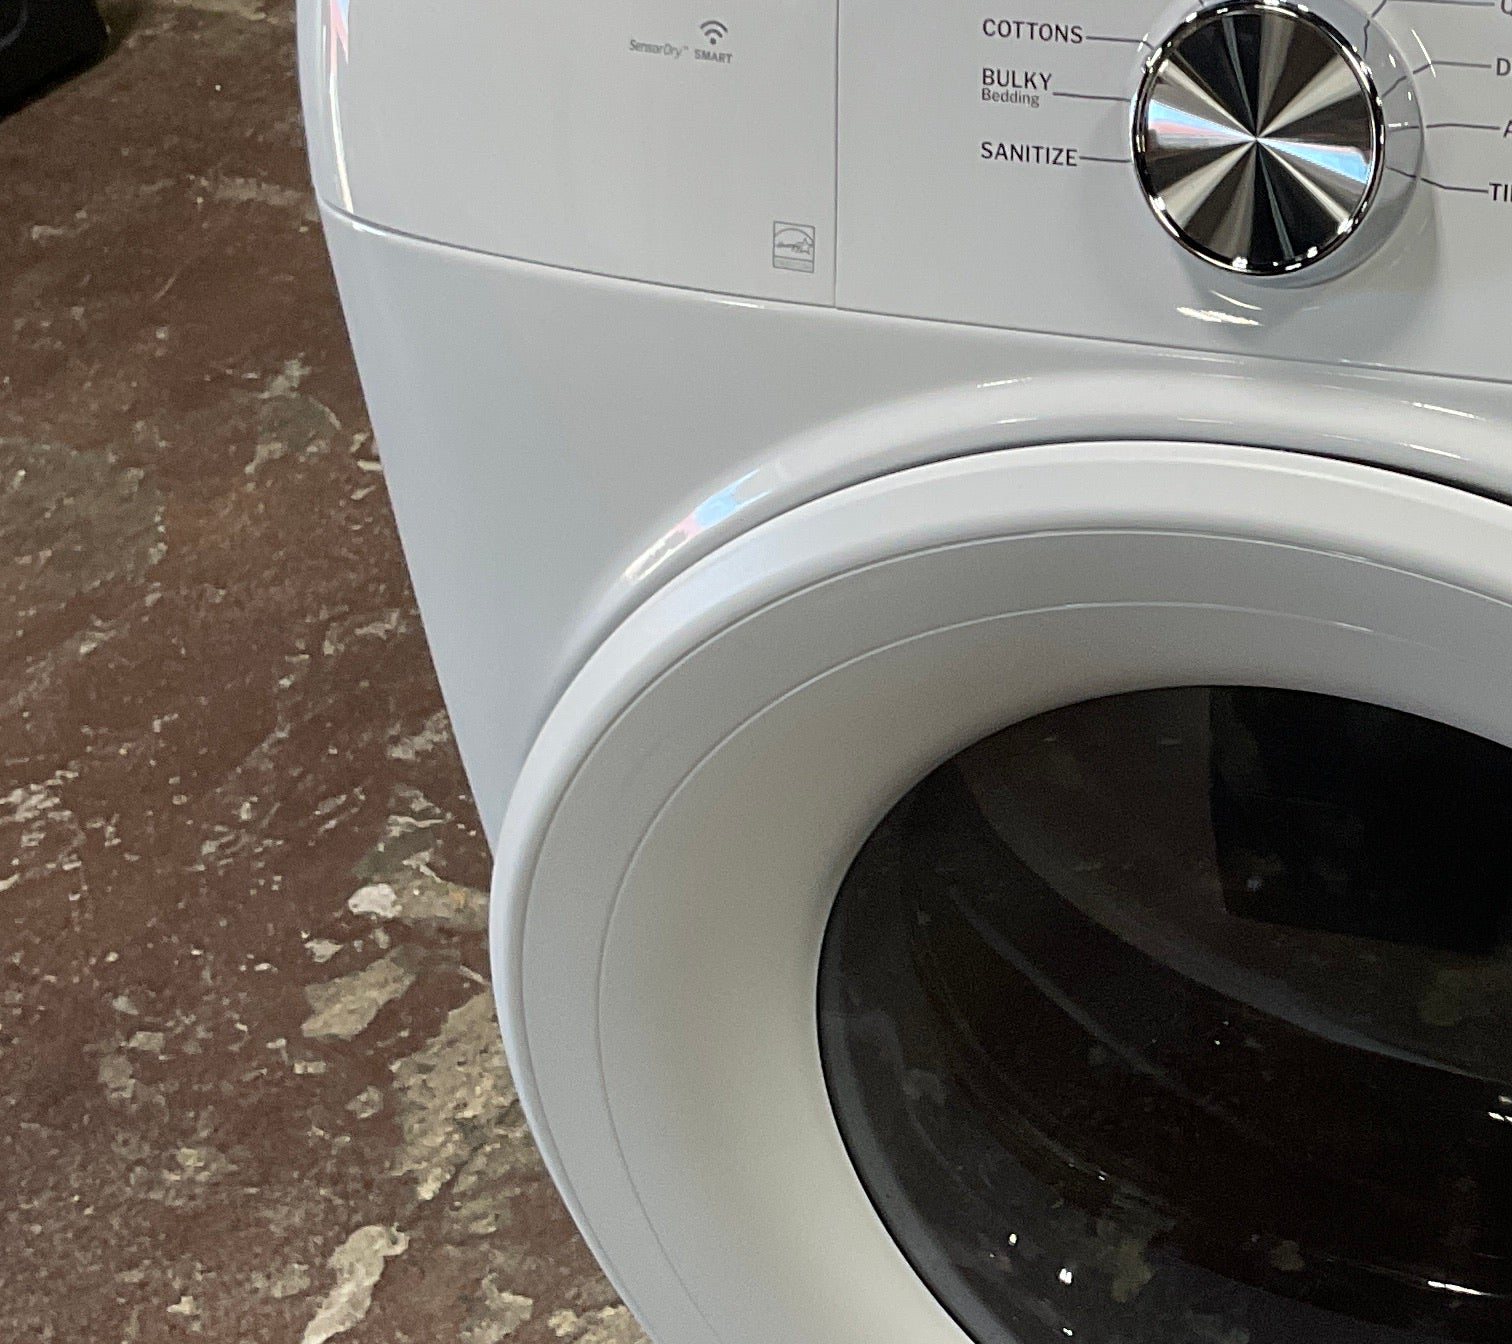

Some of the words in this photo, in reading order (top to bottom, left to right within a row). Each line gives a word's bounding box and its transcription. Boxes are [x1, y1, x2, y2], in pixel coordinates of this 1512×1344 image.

[982, 18, 1083, 44] COTTONS
[694, 49, 733, 64] SMART
[982, 67, 1052, 91] BULKY
[981, 87, 1040, 109] Bedding
[980, 141, 1078, 167] SANITIZE
